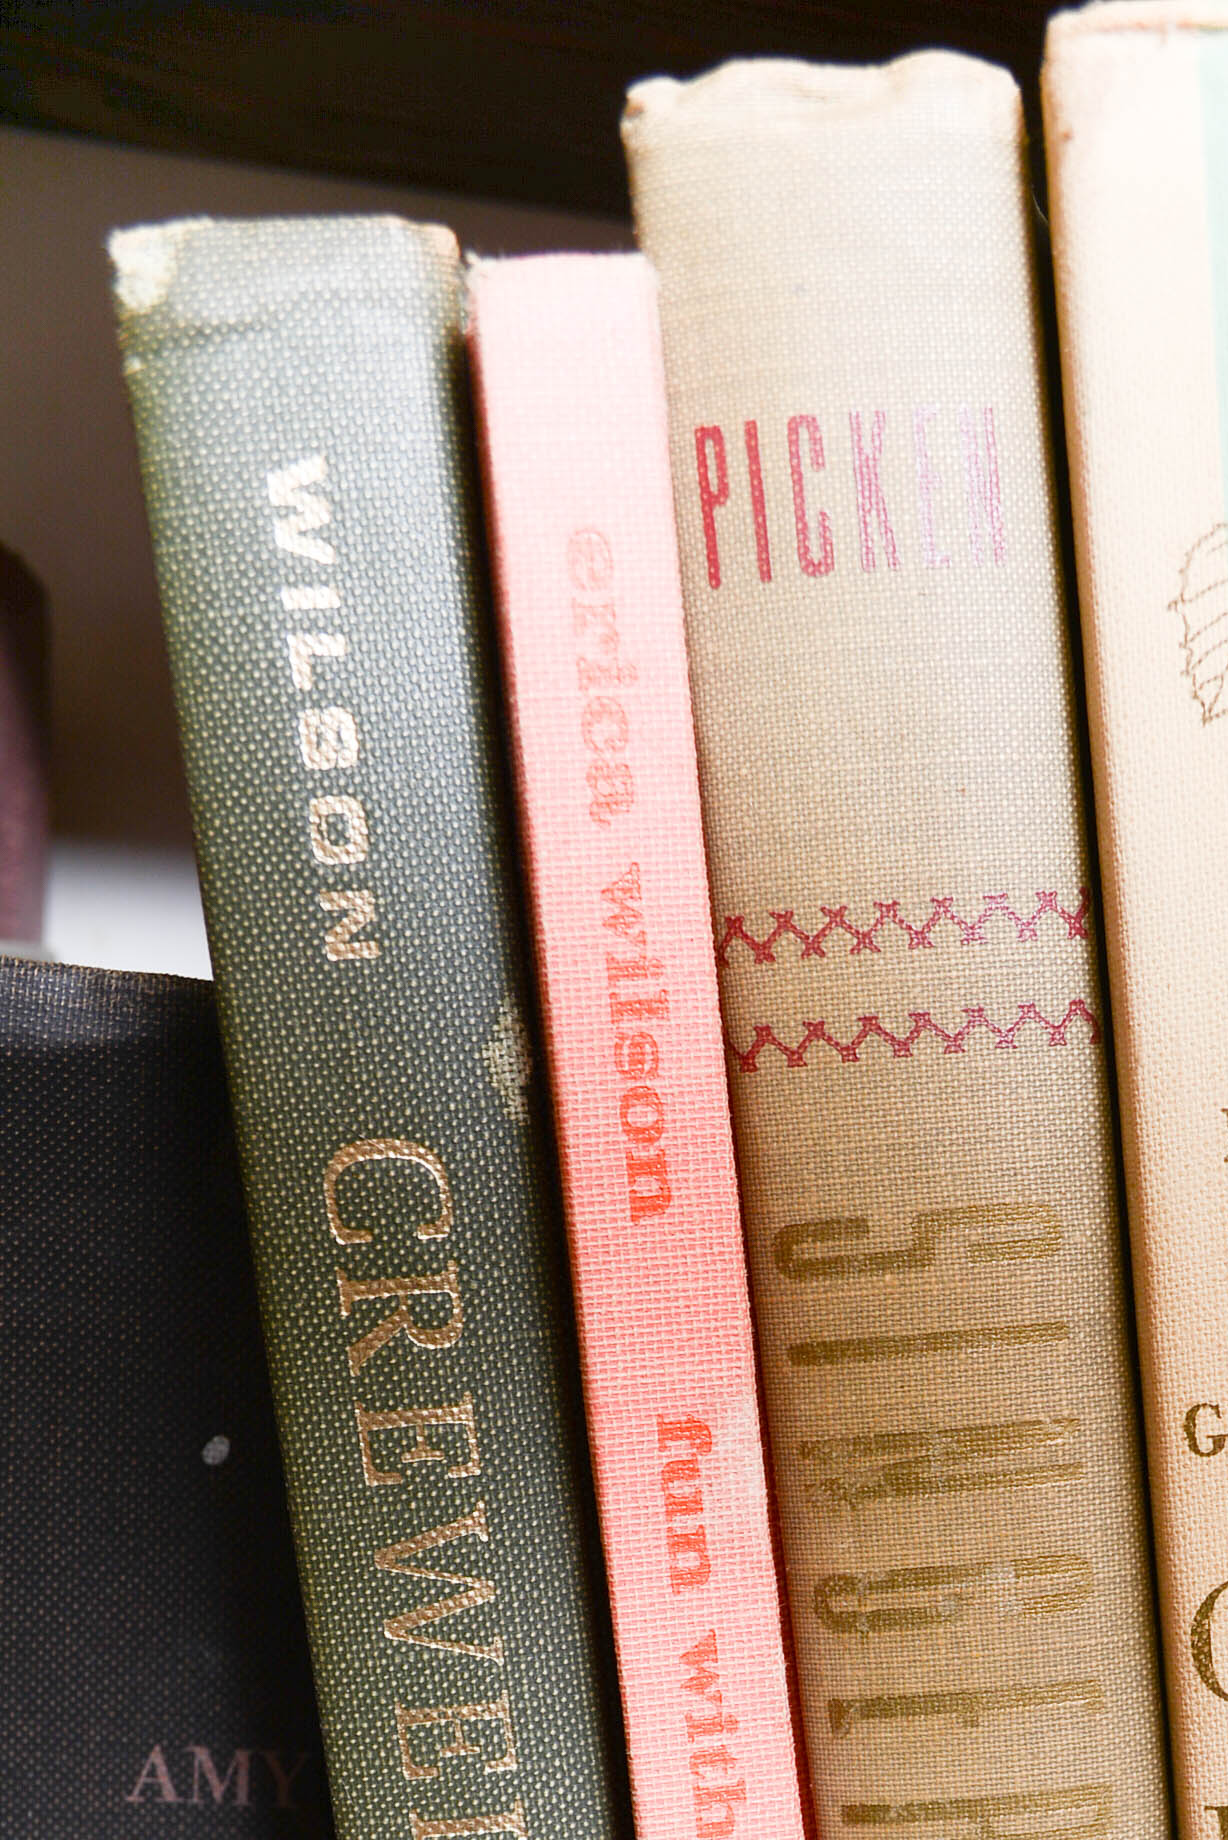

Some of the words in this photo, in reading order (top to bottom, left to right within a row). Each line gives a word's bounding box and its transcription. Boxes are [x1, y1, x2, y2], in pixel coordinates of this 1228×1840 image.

[695, 406, 1006, 589] PICKEN
[267, 455, 381, 962] WILSON
[566, 528, 640, 828] erica
[601, 861, 672, 1223] wilson
[655, 1413, 713, 1597] fun
[126, 1743, 313, 1811] AMY
